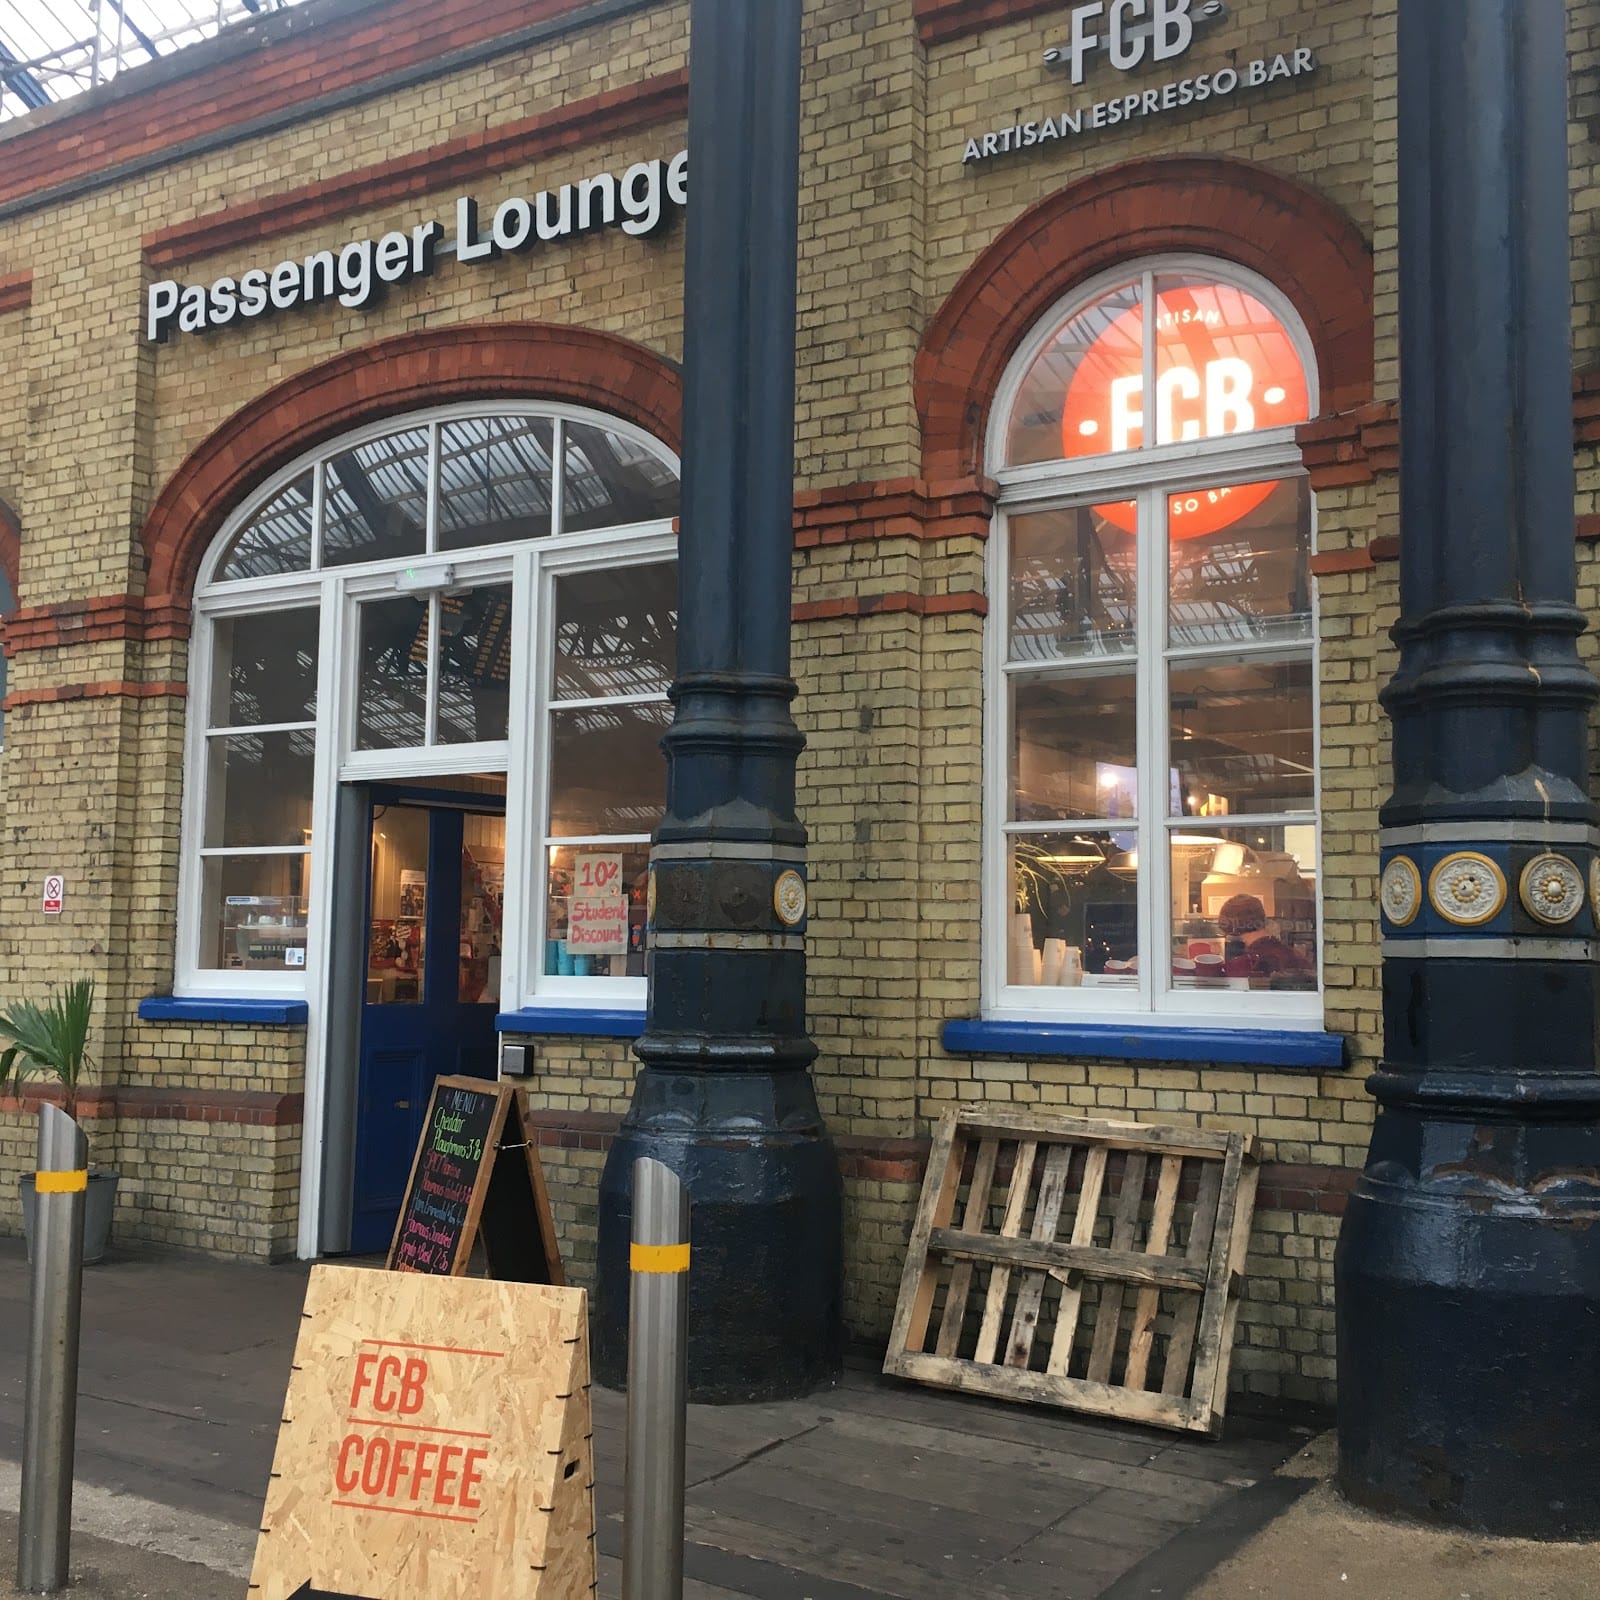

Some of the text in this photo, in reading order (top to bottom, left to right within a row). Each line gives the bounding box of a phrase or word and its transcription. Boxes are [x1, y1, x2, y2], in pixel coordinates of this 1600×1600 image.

[1071, 0, 1193, 85] FCB
[962, 47, 1314, 164] ARTISAN ESPRESSO BAR
[147, 149, 688, 341] Passenger Lounge
[1157, 308, 1220, 331] TISAN
[1111, 356, 1255, 452] FCB
[1207, 487, 1232, 504] BA
[580, 861, 618, 887] 10%
[572, 900, 626, 921] Student
[572, 924, 623, 944] Discount
[451, 1090, 477, 1114] MENU
[435, 1107, 465, 1133] Cheddar
[349, 1353, 429, 1415] FCB
[335, 1434, 489, 1510] COFFEE
